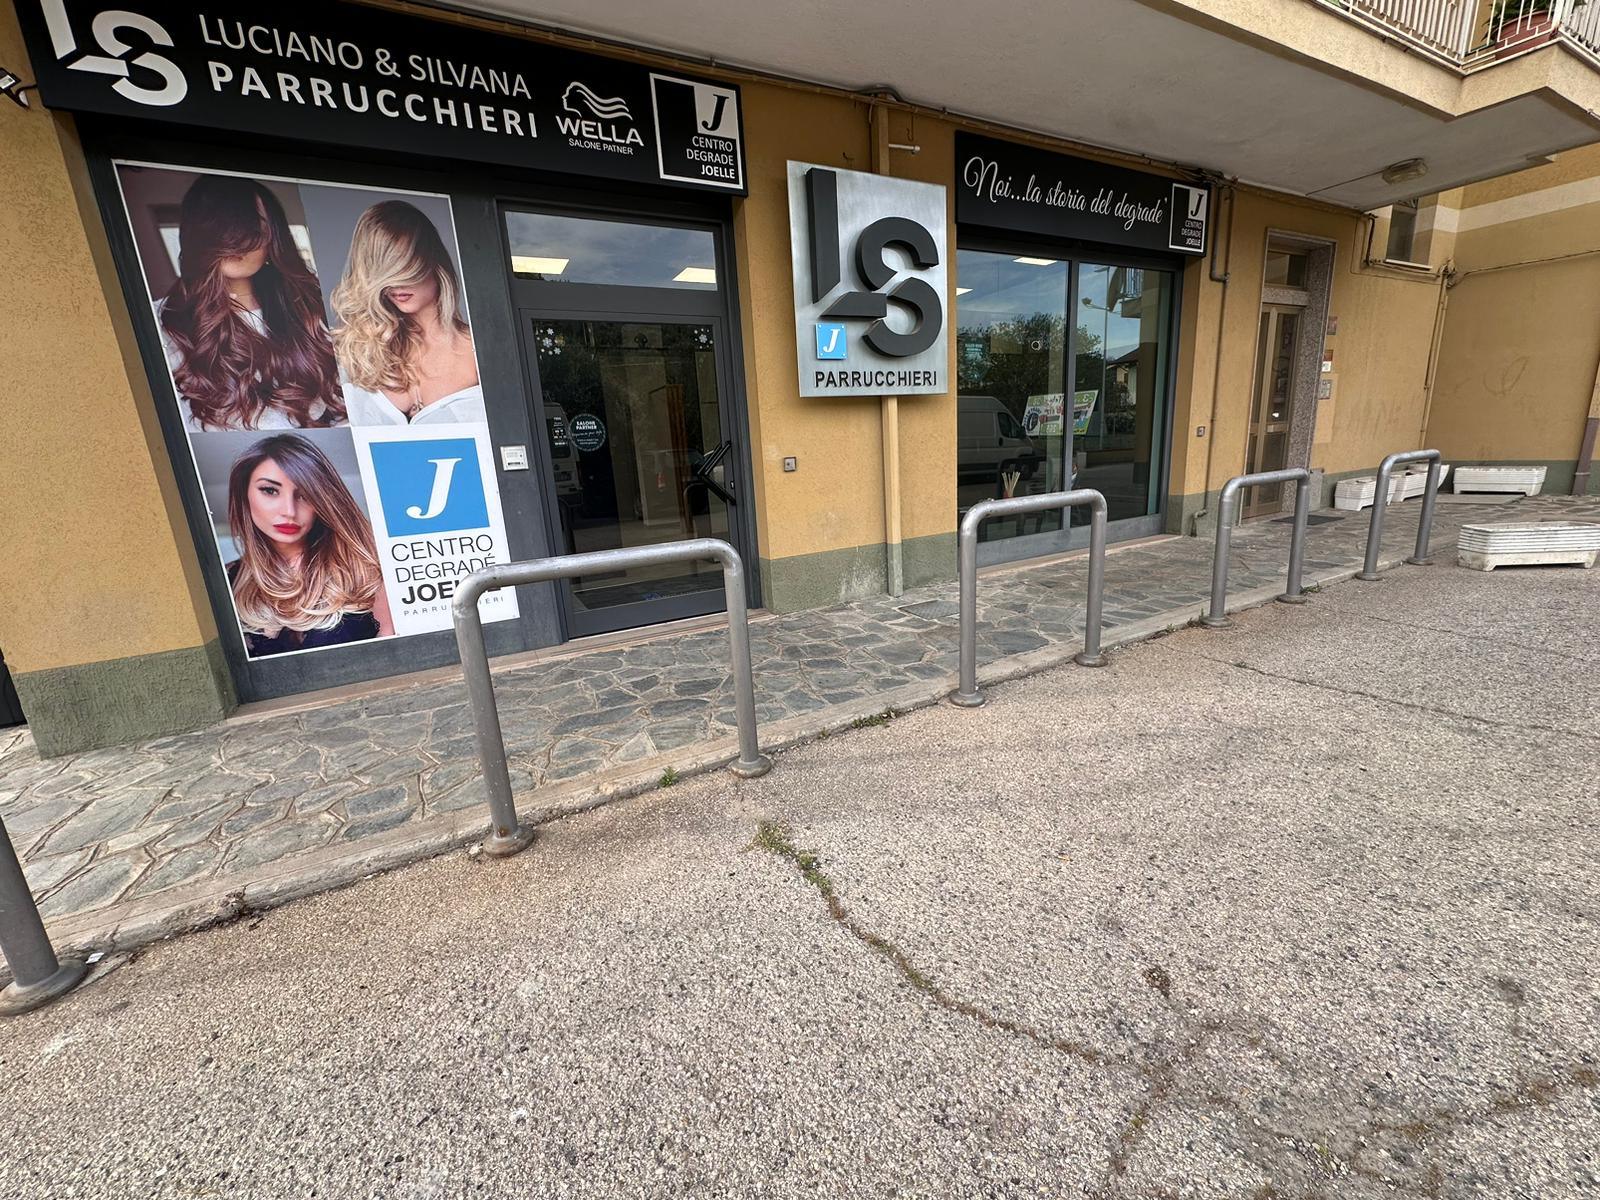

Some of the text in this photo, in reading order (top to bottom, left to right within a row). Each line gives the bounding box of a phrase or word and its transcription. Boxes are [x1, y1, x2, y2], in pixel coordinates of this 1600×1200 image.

[199, 14, 532, 99] LUCIANO & SILVANA
[207, 61, 538, 138] PARRUCCHIERI
[701, 93, 729, 132] J
[555, 115, 645, 147] WELLA
[568, 137, 634, 156] SALONE PATNER
[692, 135, 734, 153] CENTRO
[686, 148, 735, 167] DEGRADE
[701, 164, 736, 180] JOELLE
[1045, 181, 1087, 212] storia
[1090, 188, 1111, 215] del
[1190, 192, 1205, 217] J
[1181, 227, 1202, 239] DEGRADE
[1184, 219, 1203, 230] CENTRO
[1185, 237, 1201, 247] JOELLE
[822, 328, 841, 353] J
[814, 371, 938, 388] PARRUCCHIERI
[406, 457, 463, 520] J
[391, 534, 493, 562] CENTRO
[403, 596, 504, 617] PARRUIERI
